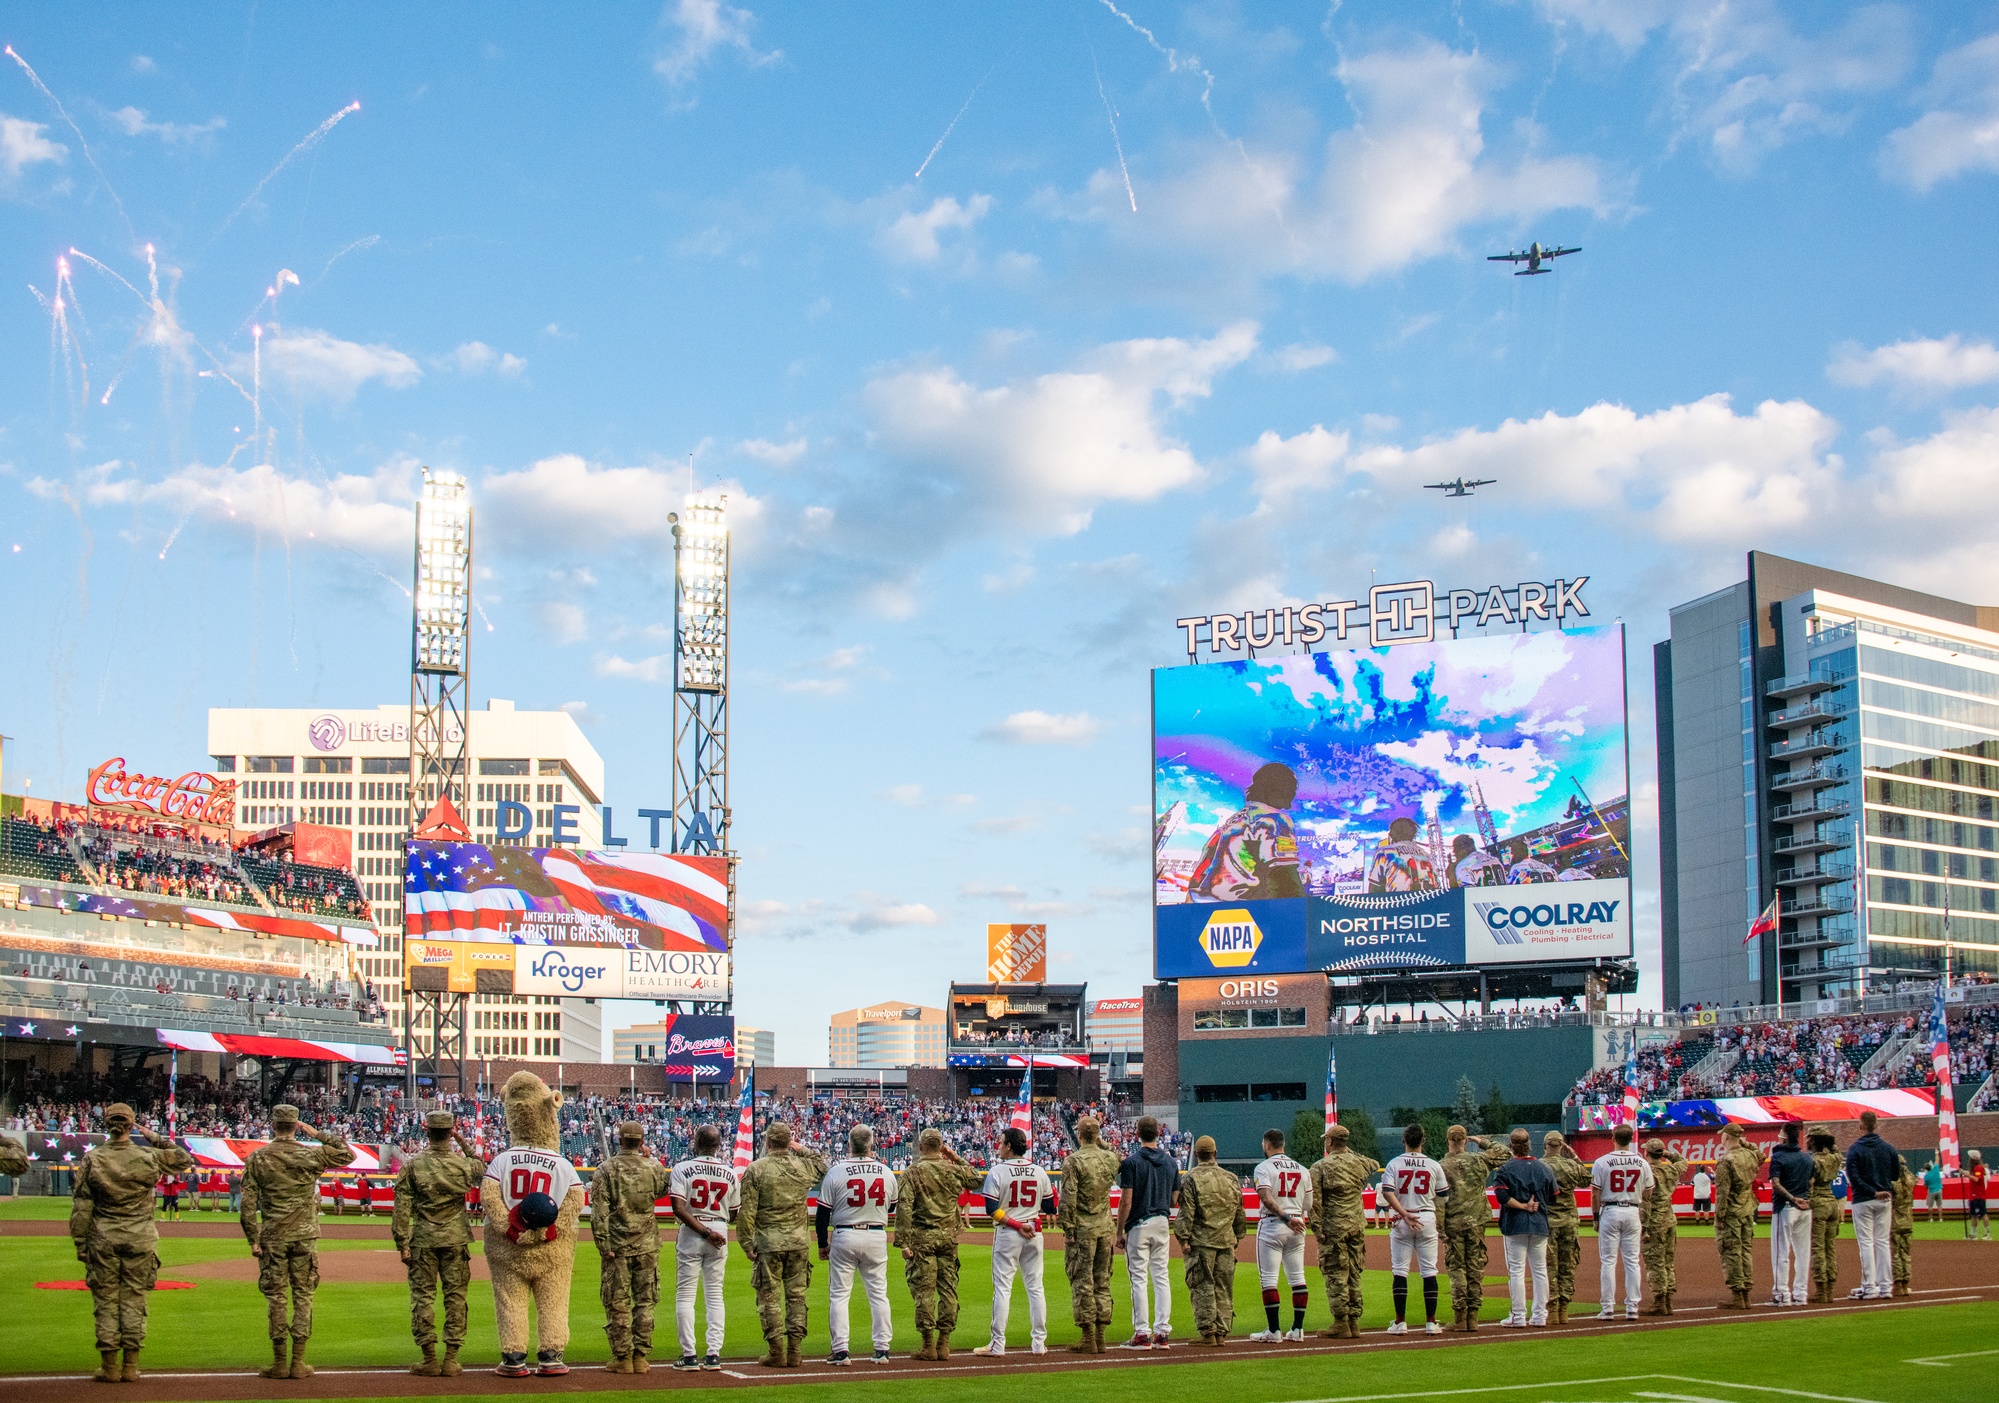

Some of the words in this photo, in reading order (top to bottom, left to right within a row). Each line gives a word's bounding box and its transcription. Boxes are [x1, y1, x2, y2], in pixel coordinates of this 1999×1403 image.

[1176, 600, 1357, 655] TRUIST
[1448, 576, 1591, 630] PARK
[86, 757, 243, 825] Coca-Cola
[497, 800, 719, 852] DELTA
[522, 911, 554, 922] ANTHEM
[556, 913, 601, 925] PERFORMED
[602, 915, 616, 926] BY:
[1320, 912, 1450, 934] NORTHSIDE
[1487, 900, 1621, 930] COOLRAY
[499, 922, 517, 939] LT.
[520, 923, 570, 941] KRISTIN
[570, 925, 640, 944] GRISSINGER
[1210, 925, 1253, 951] NAPA
[1344, 932, 1427, 946] HOSPITAL
[1523, 928, 1554, 936] Cooling
[1561, 926, 1593, 934] Heating
[1531, 935, 1569, 944] Plumbing
[1575, 933, 1614, 941] Electrical
[424, 946, 453, 957] MEGA
[993, 930, 1018, 954] THE
[628, 951, 723, 975] EMORY
[988, 924, 1046, 982] HOME
[1010, 945, 1046, 982] DEPOT
[532, 951, 606, 992] Kroger
[628, 976, 719, 990] HEALTHCARE
[1219, 979, 1279, 999] ORIS
[864, 1009, 902, 1019] Travelport
[1005, 1003, 1047, 1012] CLUBHOUSE
[1100, 1001, 1140, 1010] RaceTrac
[667, 1034, 725, 1055] Braves
[511, 1153, 557, 1171] BLOOPER
[846, 1164, 883, 1176] SEITZER
[1009, 1167, 1035, 1178] LOPEZ
[1273, 1160, 1300, 1171] PILLAR
[1404, 1158, 1426, 1168] WALL
[1606, 1158, 1643, 1168] WILLIAMS
[682, 1164, 736, 1185] WASHINGTON
[1278, 1171, 1301, 1198] 17
[1398, 1169, 1431, 1195] 73
[1610, 1169, 1641, 1193] 67
[690, 1178, 729, 1211] 37
[847, 1177, 886, 1208] 34
[1008, 1180, 1038, 1208] 15
